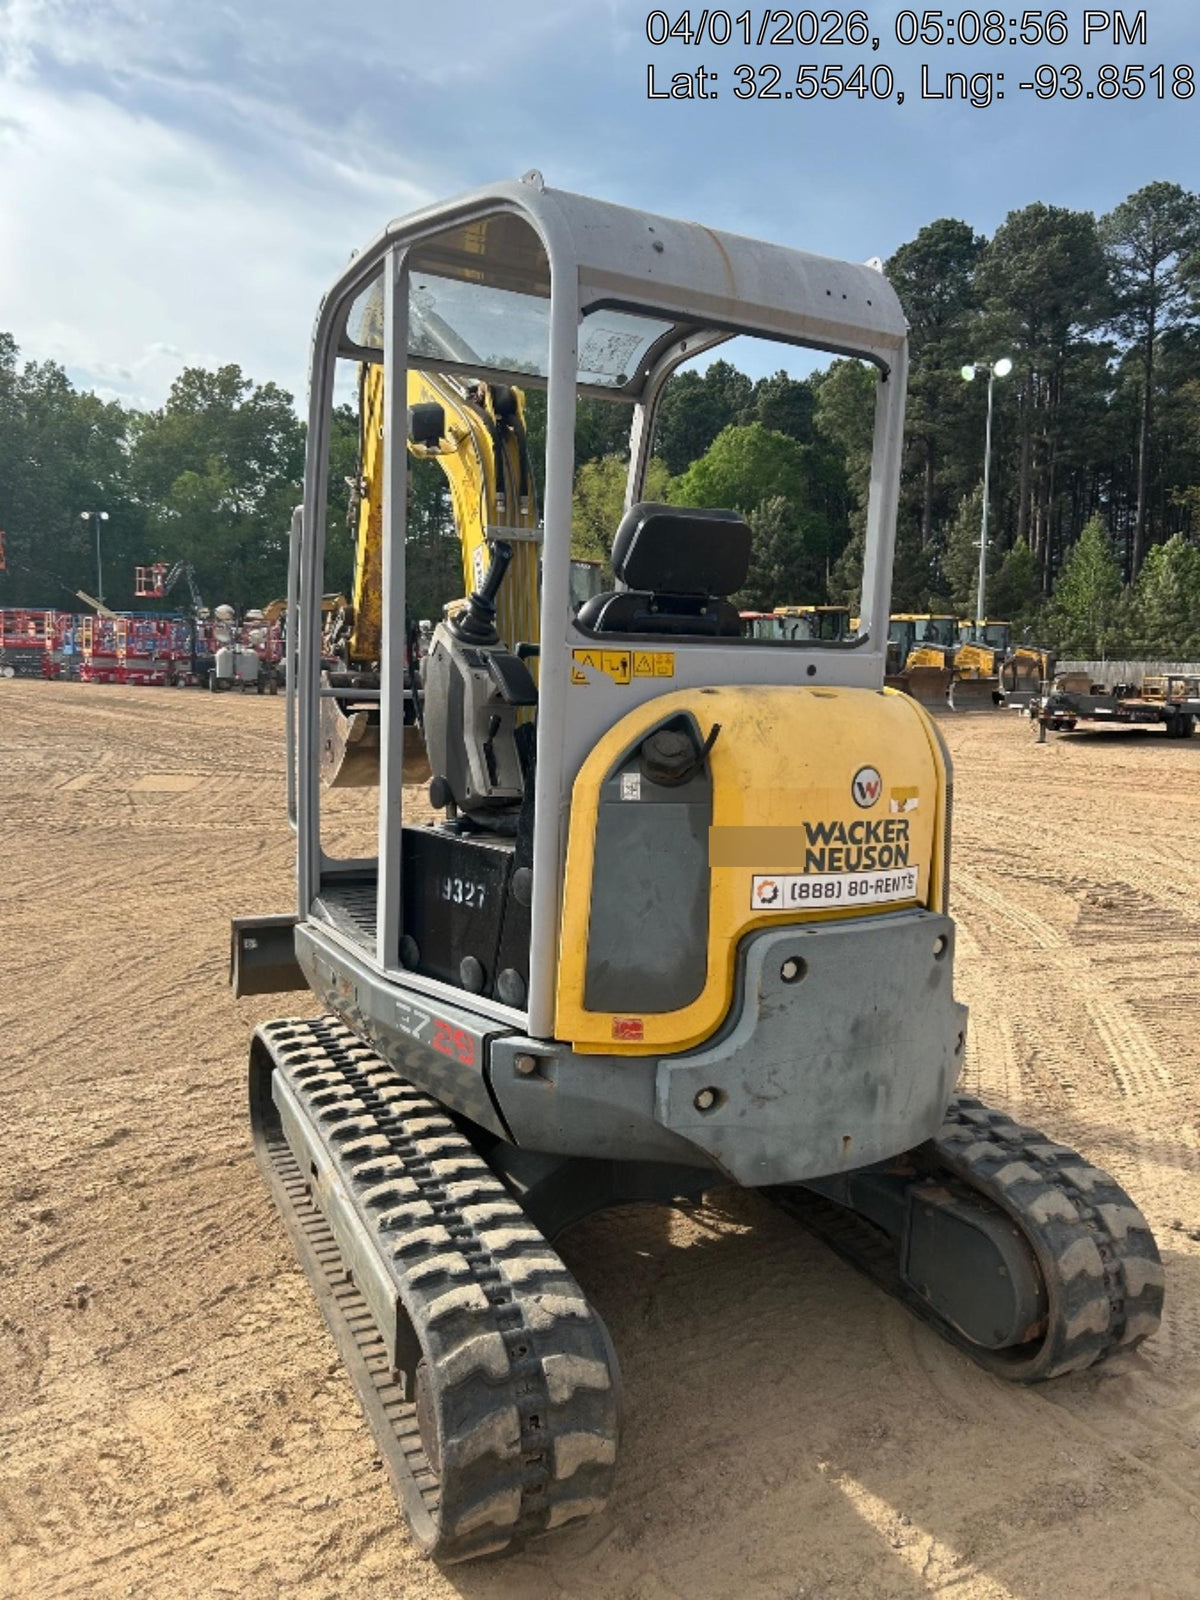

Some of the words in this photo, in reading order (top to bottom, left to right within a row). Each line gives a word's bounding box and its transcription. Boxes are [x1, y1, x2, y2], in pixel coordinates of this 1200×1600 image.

[803, 818, 909, 846] WACKER
[804, 843, 909, 872] NEUSON
[791, 881, 842, 900] (888)
